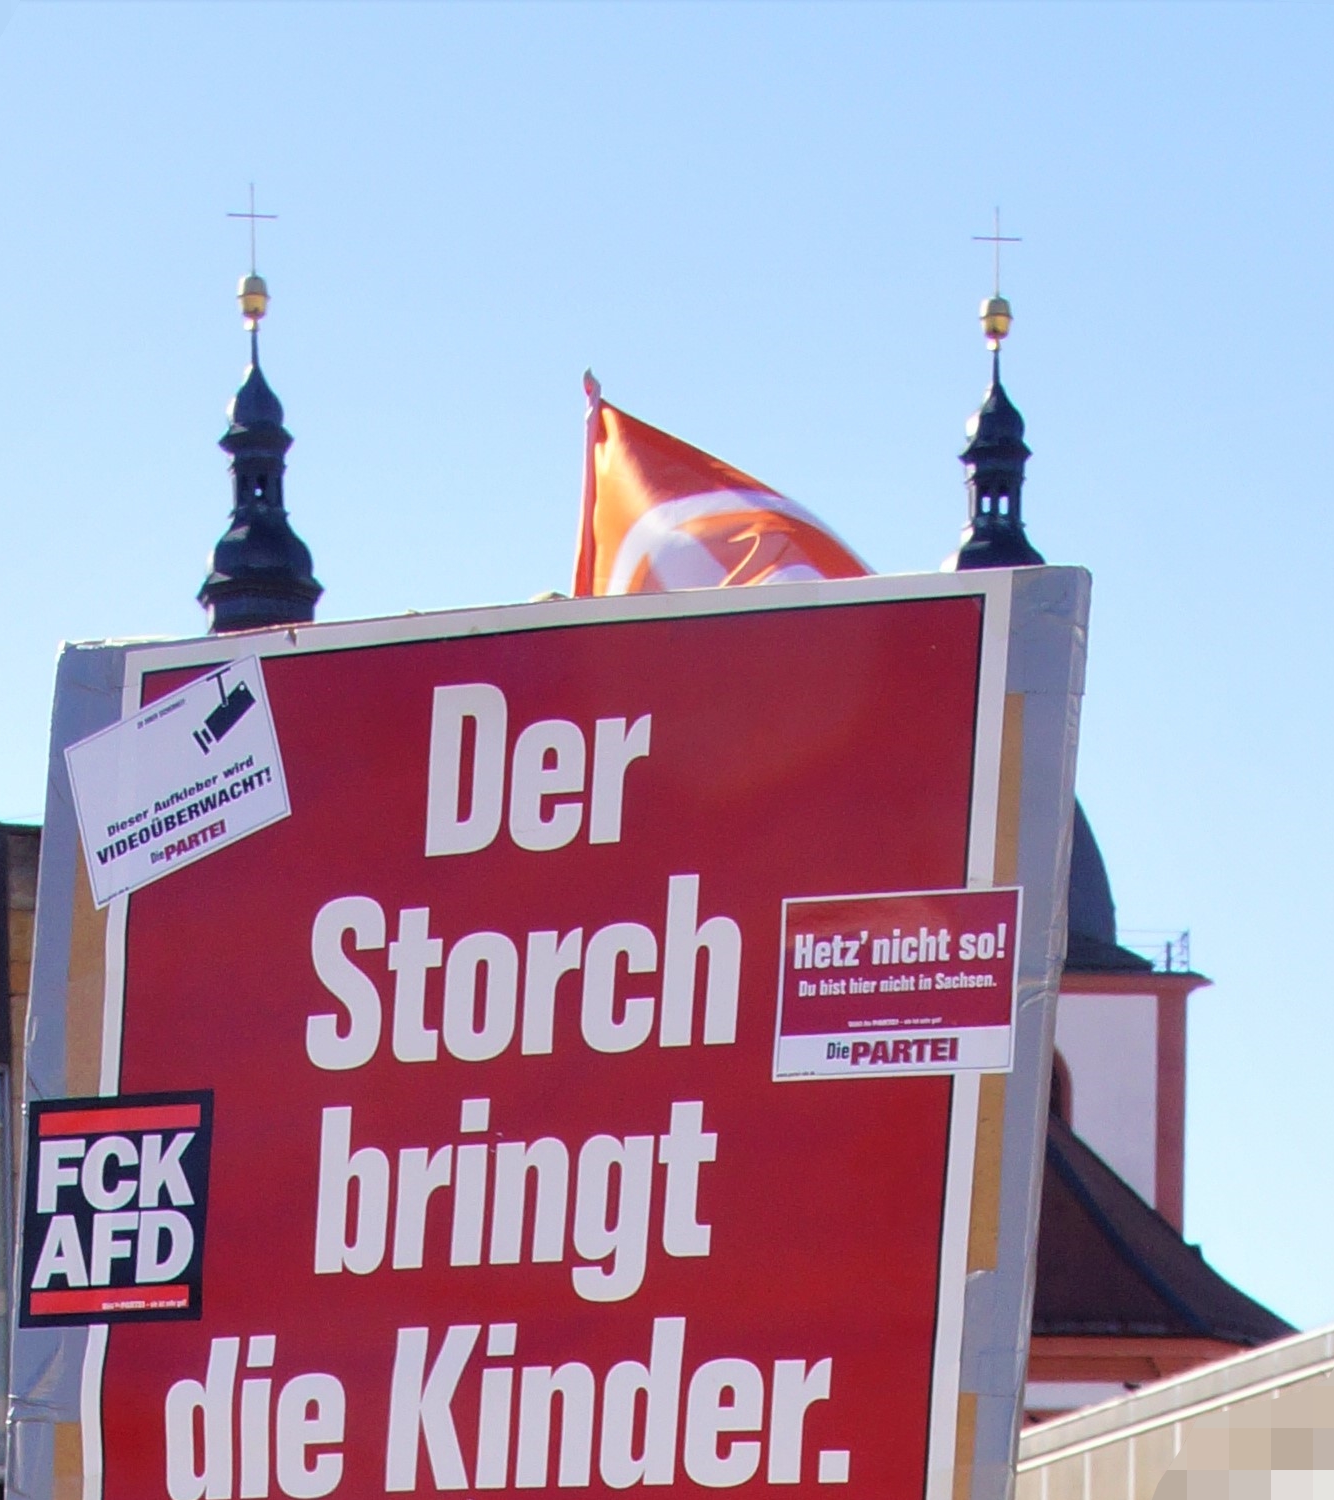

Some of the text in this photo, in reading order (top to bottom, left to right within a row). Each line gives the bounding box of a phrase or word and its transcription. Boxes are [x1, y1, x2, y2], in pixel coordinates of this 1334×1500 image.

[106, 755, 254, 837] Dieser Aufkleber wird
[425, 682, 651, 859] Der
[96, 767, 273, 865] VIDEOÜBERWACHT!
[305, 873, 743, 1072] Storch
[798, 972, 997, 997] Du bist hier nicht in Sachsen.
[871, 927, 951, 966] nicht
[959, 923, 1007, 961] so!
[37, 1132, 196, 1214] FCK
[313, 1097, 718, 1301] bringt
[31, 1210, 194, 1289] AFD
[385, 1317, 851, 1493] Kinder.
